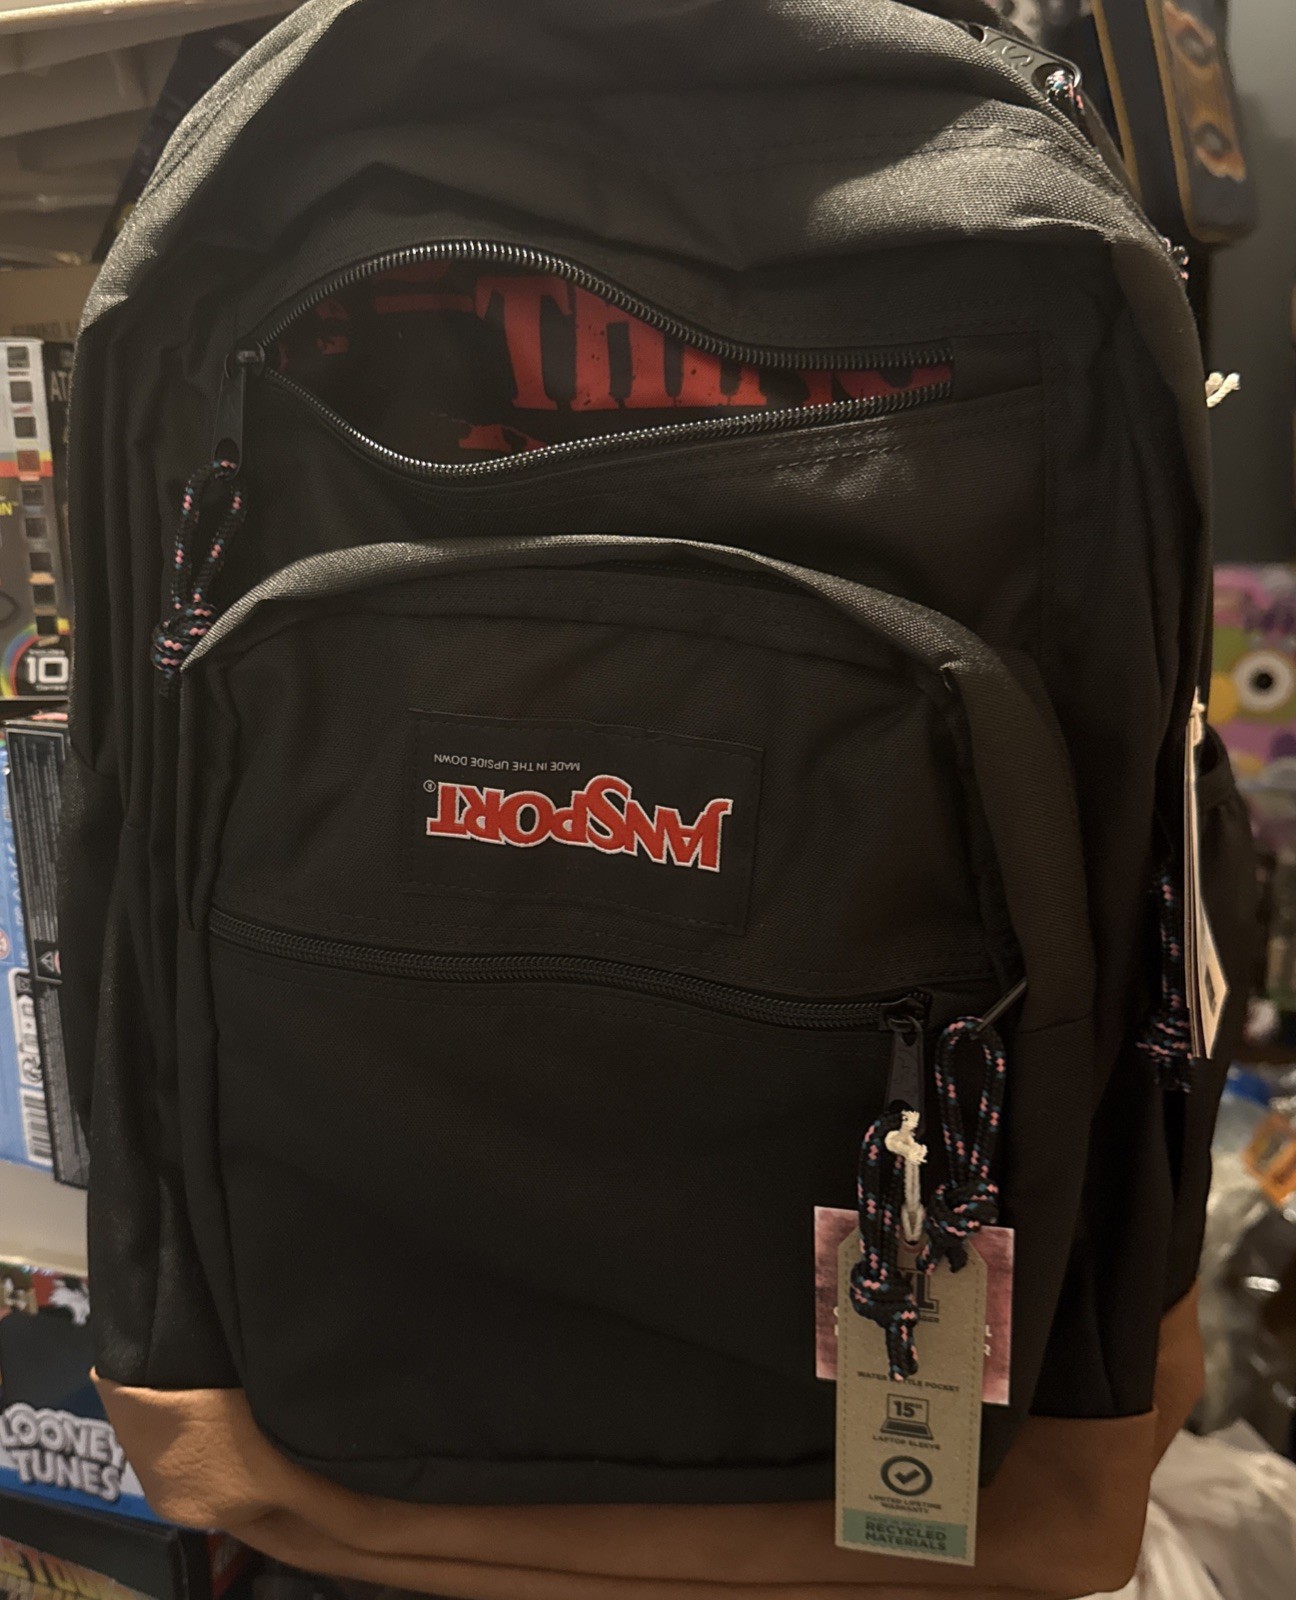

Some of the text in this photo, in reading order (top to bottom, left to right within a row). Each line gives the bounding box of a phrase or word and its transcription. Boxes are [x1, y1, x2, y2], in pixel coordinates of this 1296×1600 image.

[50, 370, 73, 402] AT
[26, 656, 69, 685] 10
[433, 753, 581, 772] MADE IN THE UPSIDE DOWN
[857, 1371, 888, 1382] WATER
[924, 1381, 961, 1393] POCKET
[0, 1402, 126, 1470] LOONEY
[872, 1434, 907, 1446] LAPTOP
[10, 1447, 122, 1503] TUNES
[865, 1520, 947, 1542] RECYCLED
[865, 1532, 946, 1551] MATERIALS
